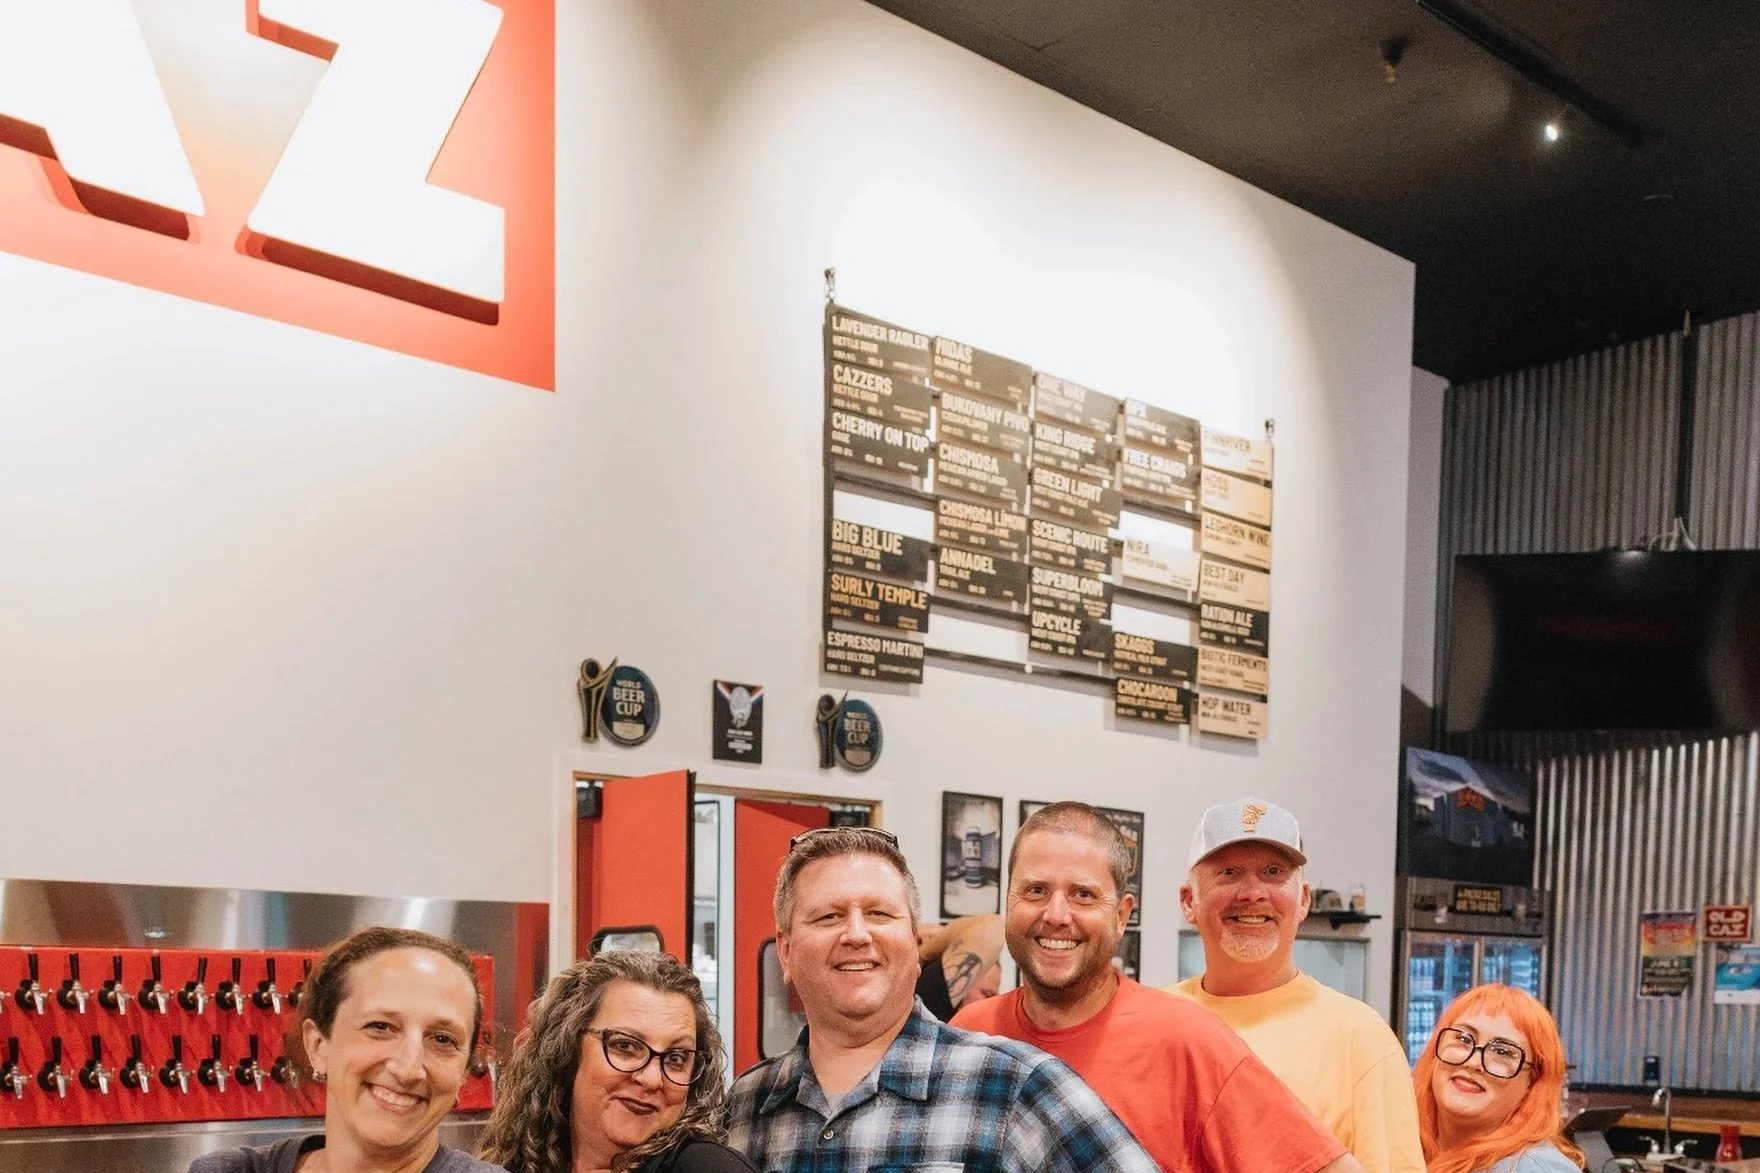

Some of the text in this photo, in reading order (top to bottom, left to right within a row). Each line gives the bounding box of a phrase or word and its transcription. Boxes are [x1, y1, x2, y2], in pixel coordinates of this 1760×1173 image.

[832, 315, 929, 351] LAVENDER RADLER
[935, 337, 973, 364] MIDAS
[833, 364, 893, 396] CAZZERS
[832, 411, 883, 440] CHERRY
[884, 426, 903, 447] ON
[904, 431, 930, 453] TOP
[1035, 423, 1063, 446] KING
[1063, 430, 1096, 456] RIDGE
[939, 443, 1000, 475] CHISMOSA
[1033, 467, 1071, 493] GREEN
[1071, 478, 1103, 503] LIGHT
[939, 499, 993, 525] CHISMOSA
[832, 519, 903, 556] BIG BLUE
[1031, 519, 1109, 554] SCENIC ROUTE
[1204, 514, 1269, 548] LEGHORN WINE
[940, 547, 997, 575] ANNADEL
[1203, 563, 1245, 584] BEST DAY
[831, 573, 875, 598] SURLY
[877, 583, 928, 610] TEMPLE
[1031, 566, 1104, 597] SUPERBLOOM
[1031, 610, 1082, 636] UPCYCLE
[1235, 611, 1253, 628] ALE
[827, 631, 923, 660] ESPRESSO MARTINI
[612, 687, 645, 703] BEER
[616, 679, 643, 689] WORLD
[615, 701, 642, 717] CUP
[1222, 700, 1252, 716] WATER
[844, 718, 871, 733] BEER
[847, 731, 869, 744] CUP
[1708, 911, 1746, 923] OLD
[1708, 923, 1745, 936] CAZ
